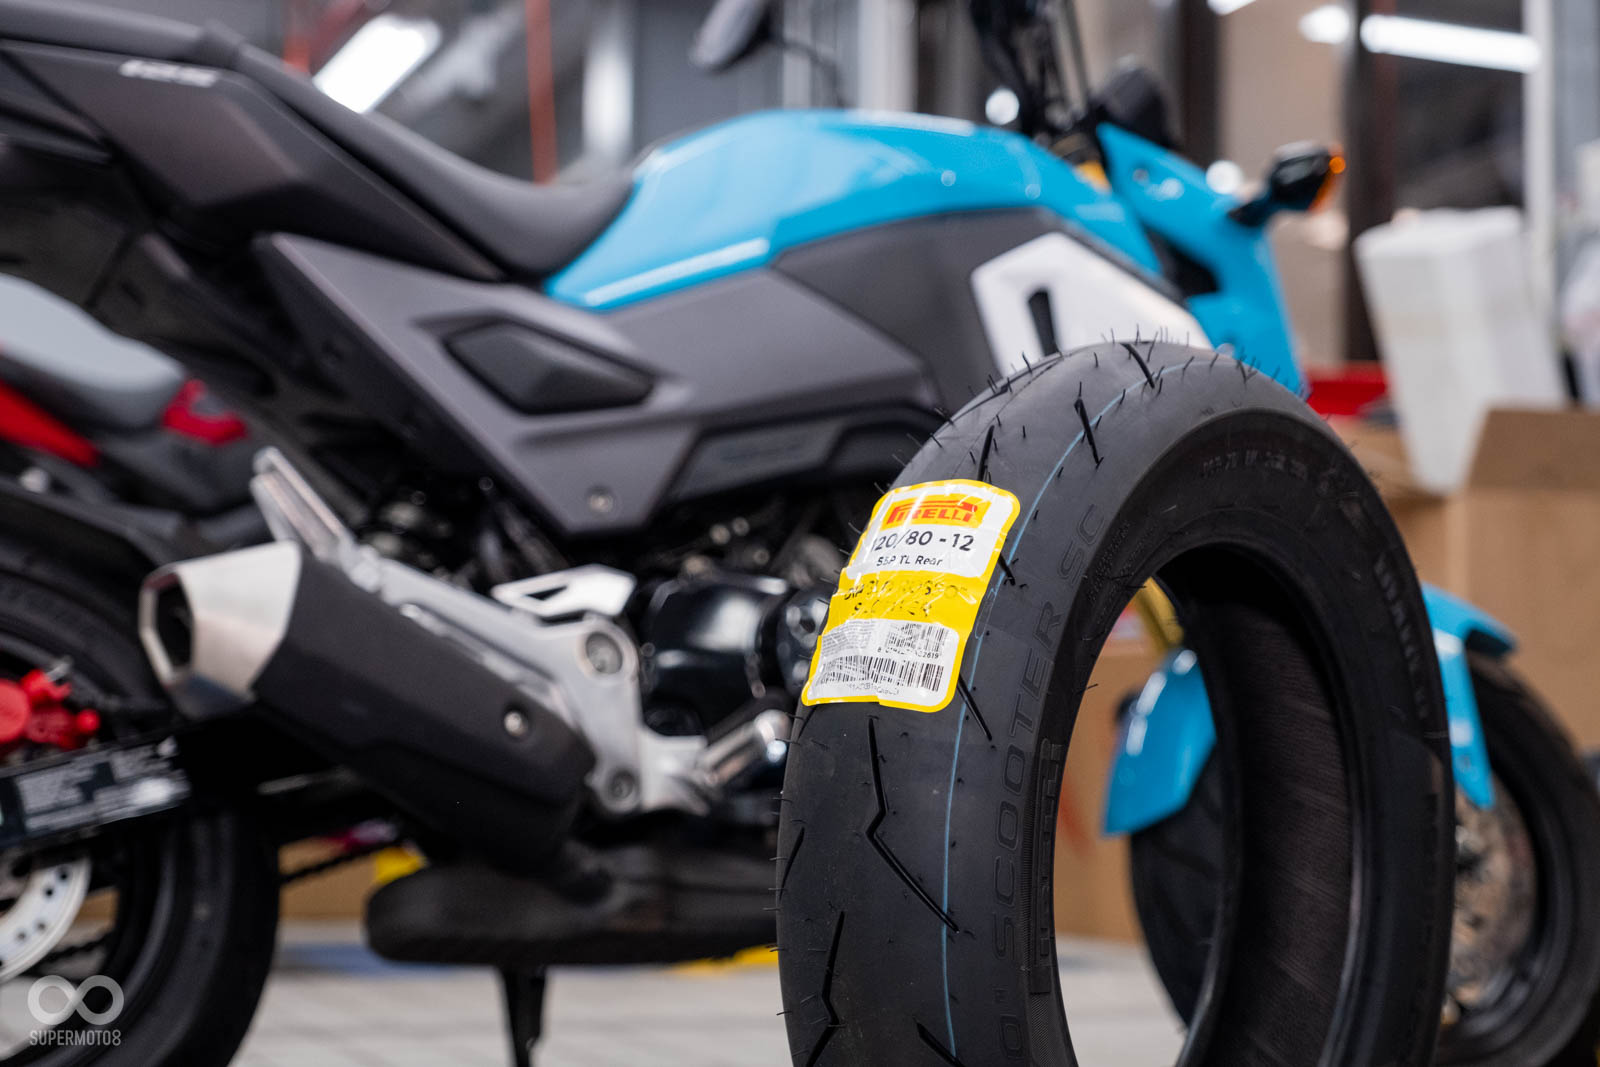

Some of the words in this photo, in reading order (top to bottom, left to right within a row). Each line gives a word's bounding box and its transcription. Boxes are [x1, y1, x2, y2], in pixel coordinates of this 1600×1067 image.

[887, 500, 978, 525] PIRELLI
[871, 529, 933, 552] 120/80
[952, 533, 974, 551] 12
[899, 554, 911, 564] TL
[915, 555, 943, 566] Rear
[993, 599, 1064, 961] SCOOTER
[1057, 503, 1106, 586] SC
